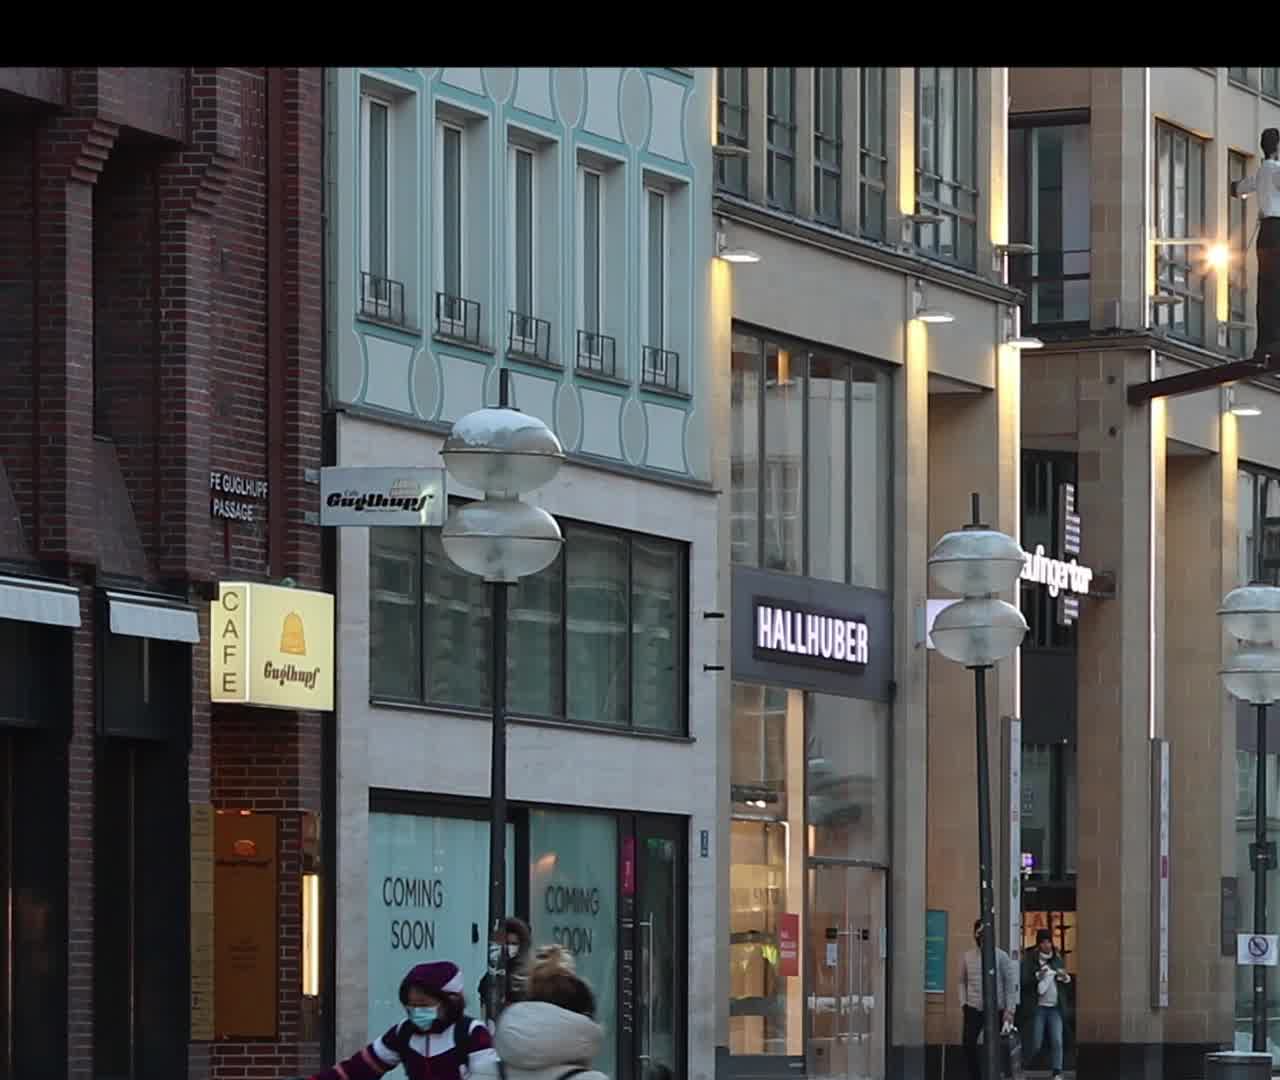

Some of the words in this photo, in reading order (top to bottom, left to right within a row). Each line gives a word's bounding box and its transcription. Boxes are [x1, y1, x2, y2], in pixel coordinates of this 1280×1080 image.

[213, 498, 254, 521] PASSAGE
[326, 492, 434, 512] Guglhupf
[222, 591, 239, 693] CAFE
[758, 606, 868, 664] HALLHUBER
[263, 660, 320, 690] Guglhupf
[383, 877, 443, 909] COMING
[545, 885, 600, 915] COMING
[391, 920, 434, 950] SOON
[554, 926, 593, 954] SOON
